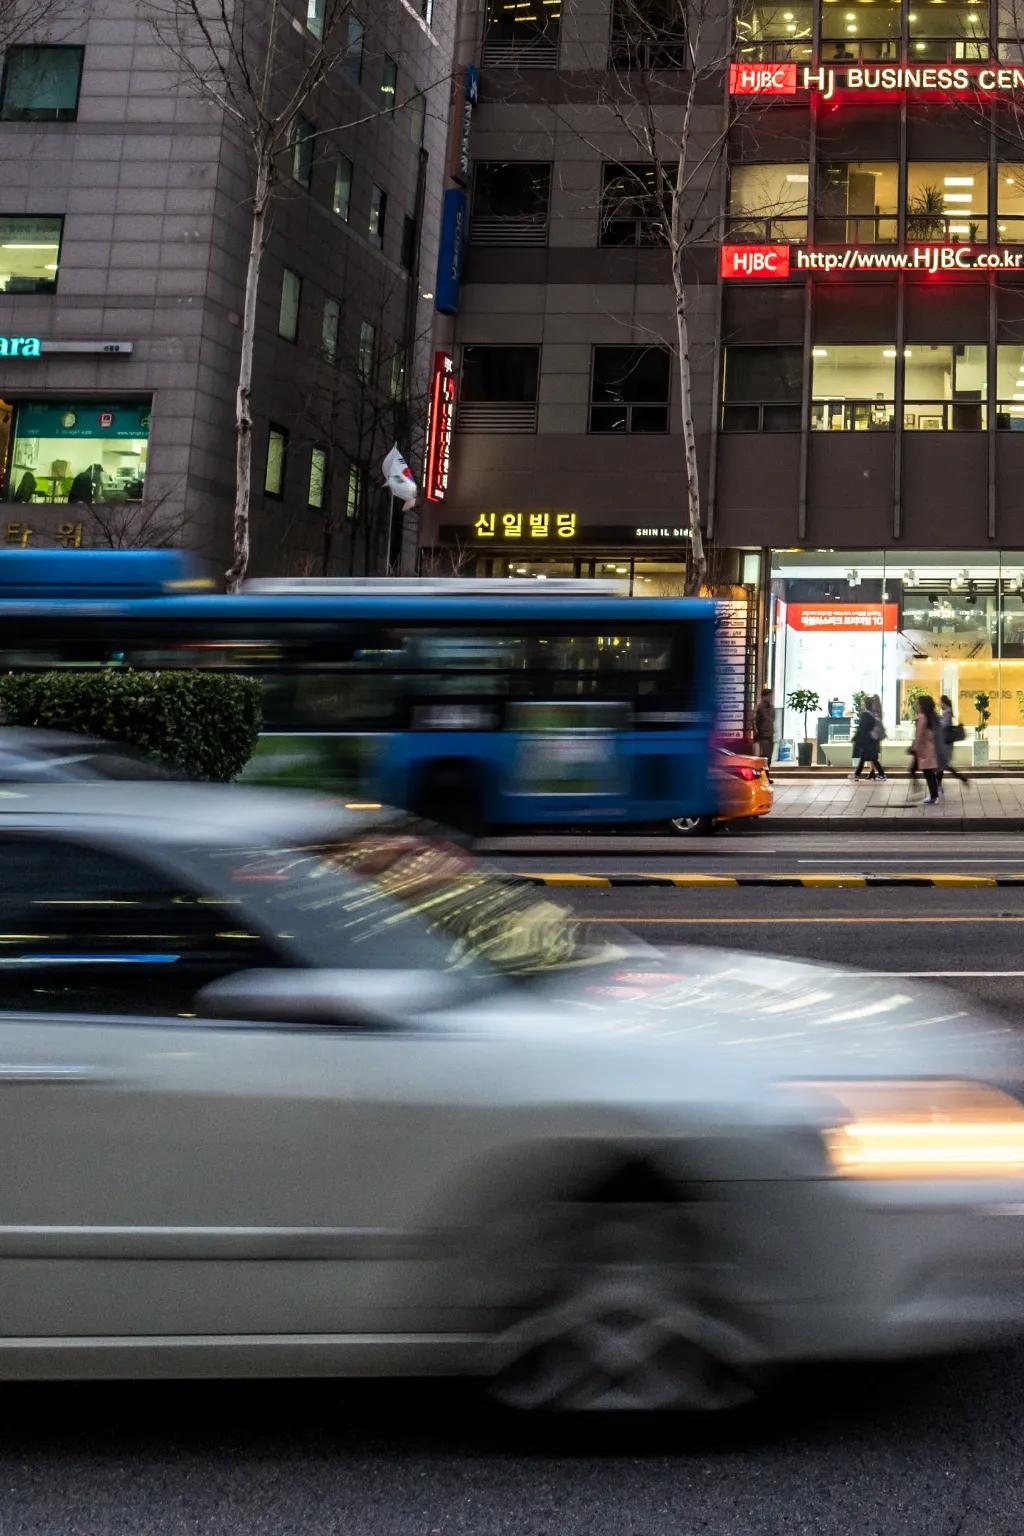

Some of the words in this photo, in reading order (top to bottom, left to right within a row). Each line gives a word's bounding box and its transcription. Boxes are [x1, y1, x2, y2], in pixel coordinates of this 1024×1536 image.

[741, 70, 785, 91] HJBC
[803, 67, 834, 99] HJ
[847, 68, 969, 89] BUSINESS
[733, 252, 778, 275] HJBC
[797, 247, 1023, 274] http://www.HJBC.co.kr
[474, 512, 577, 538] 신일빌딩
[636, 528, 659, 537] SHIN
